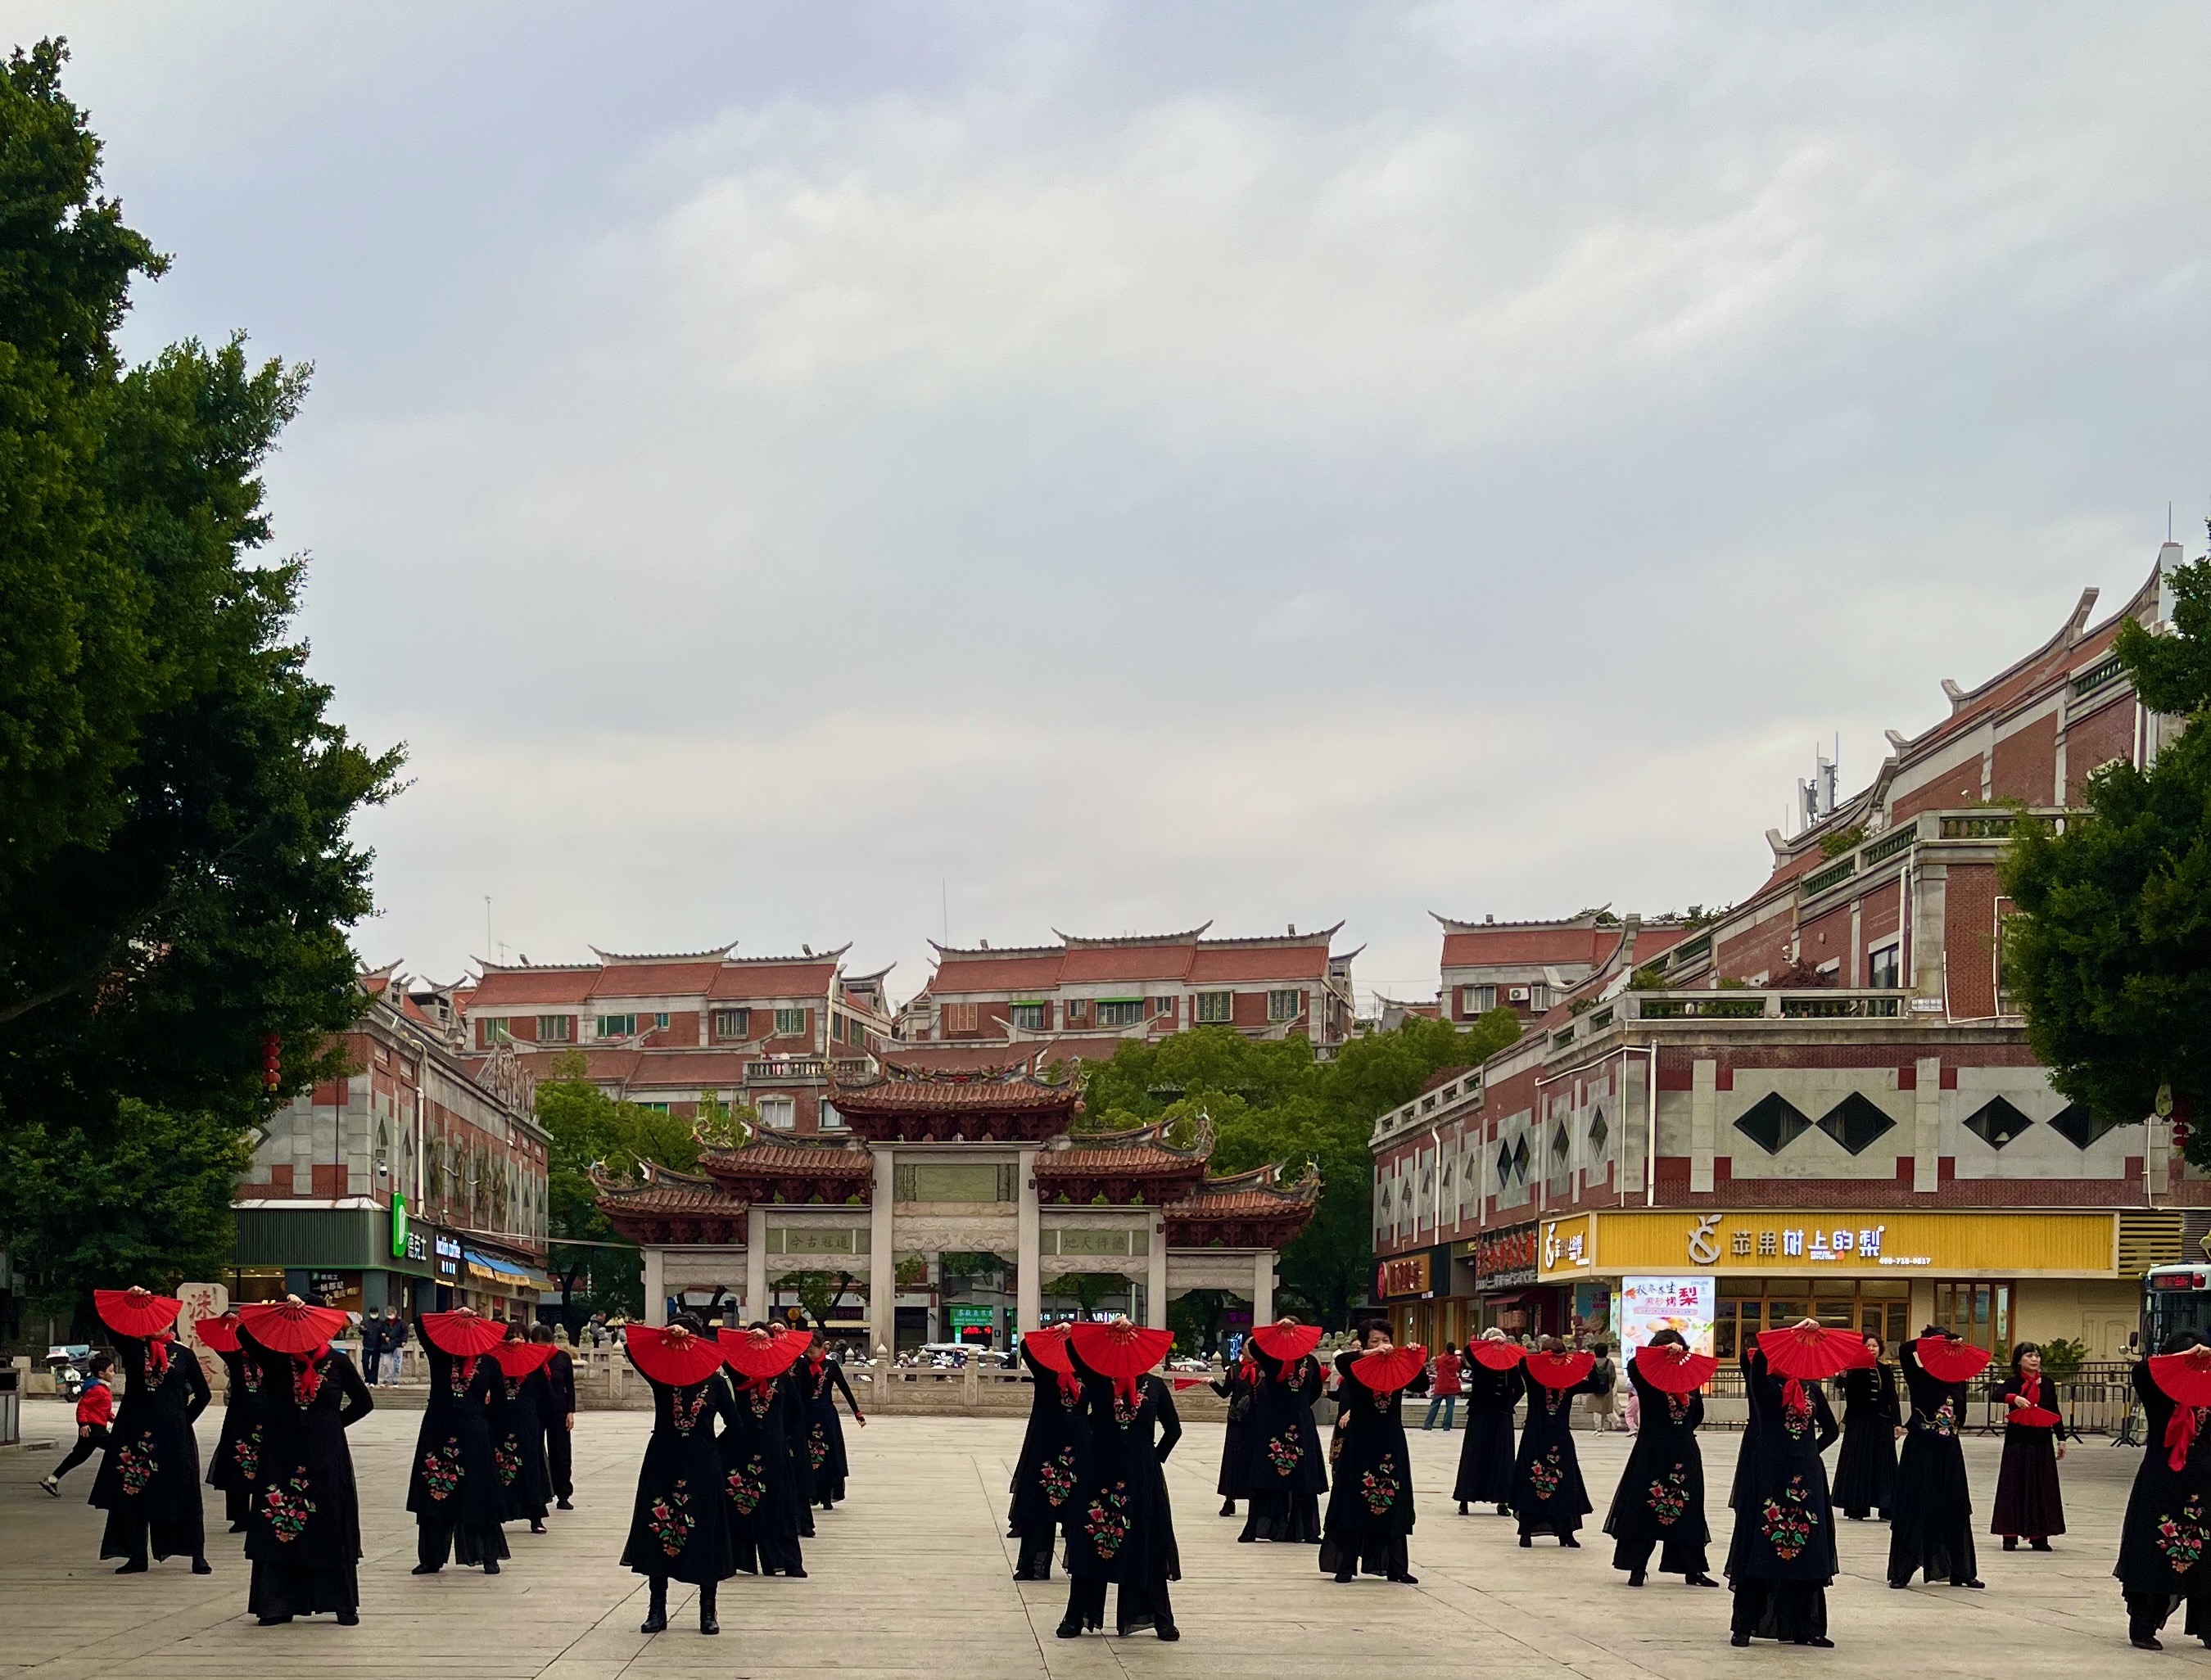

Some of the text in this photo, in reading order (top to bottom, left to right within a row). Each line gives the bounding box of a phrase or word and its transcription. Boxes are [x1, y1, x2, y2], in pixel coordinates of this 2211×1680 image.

[1732, 1230, 1880, 1257] 苹果树上的梨
